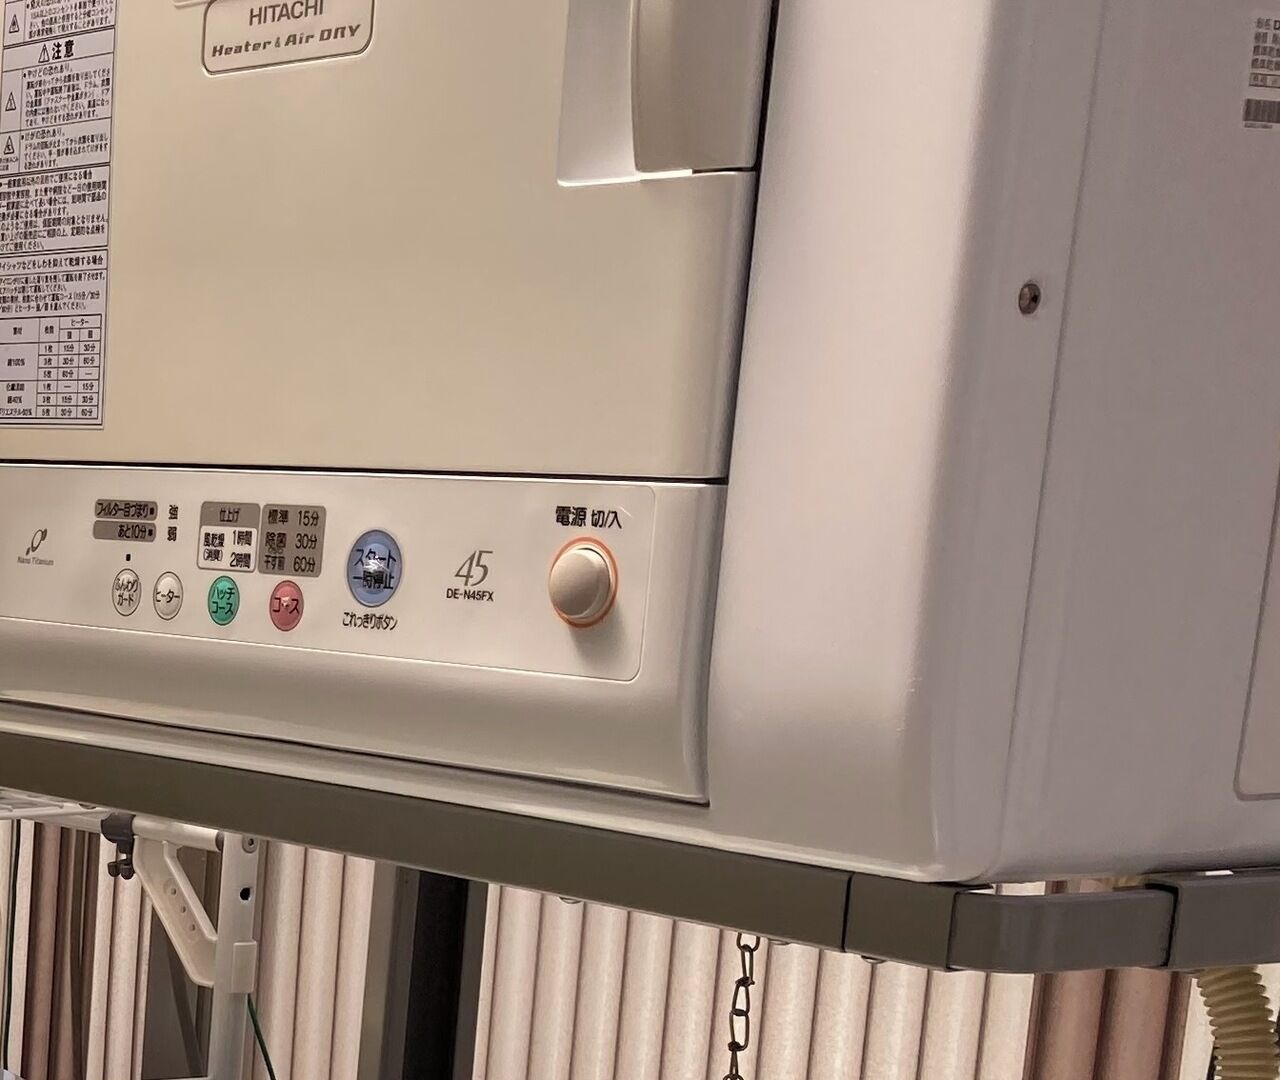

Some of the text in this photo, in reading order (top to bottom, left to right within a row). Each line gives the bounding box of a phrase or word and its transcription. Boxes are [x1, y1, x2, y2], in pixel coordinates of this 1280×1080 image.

[248, 0, 324, 26] HITACHI
[51, 39, 75, 60] 注意
[211, 40, 272, 57] Heater
[284, 32, 315, 47] Air
[318, 24, 361, 42] DRY
[297, 510, 320, 527] 15分
[555, 505, 623, 530] 電源 切/入
[294, 533, 318, 550] 30分
[293, 556, 316, 573] 60分
[454, 549, 494, 587] 45
[446, 588, 495, 602] DE-N45FX
[212, 601, 234, 616] コース
